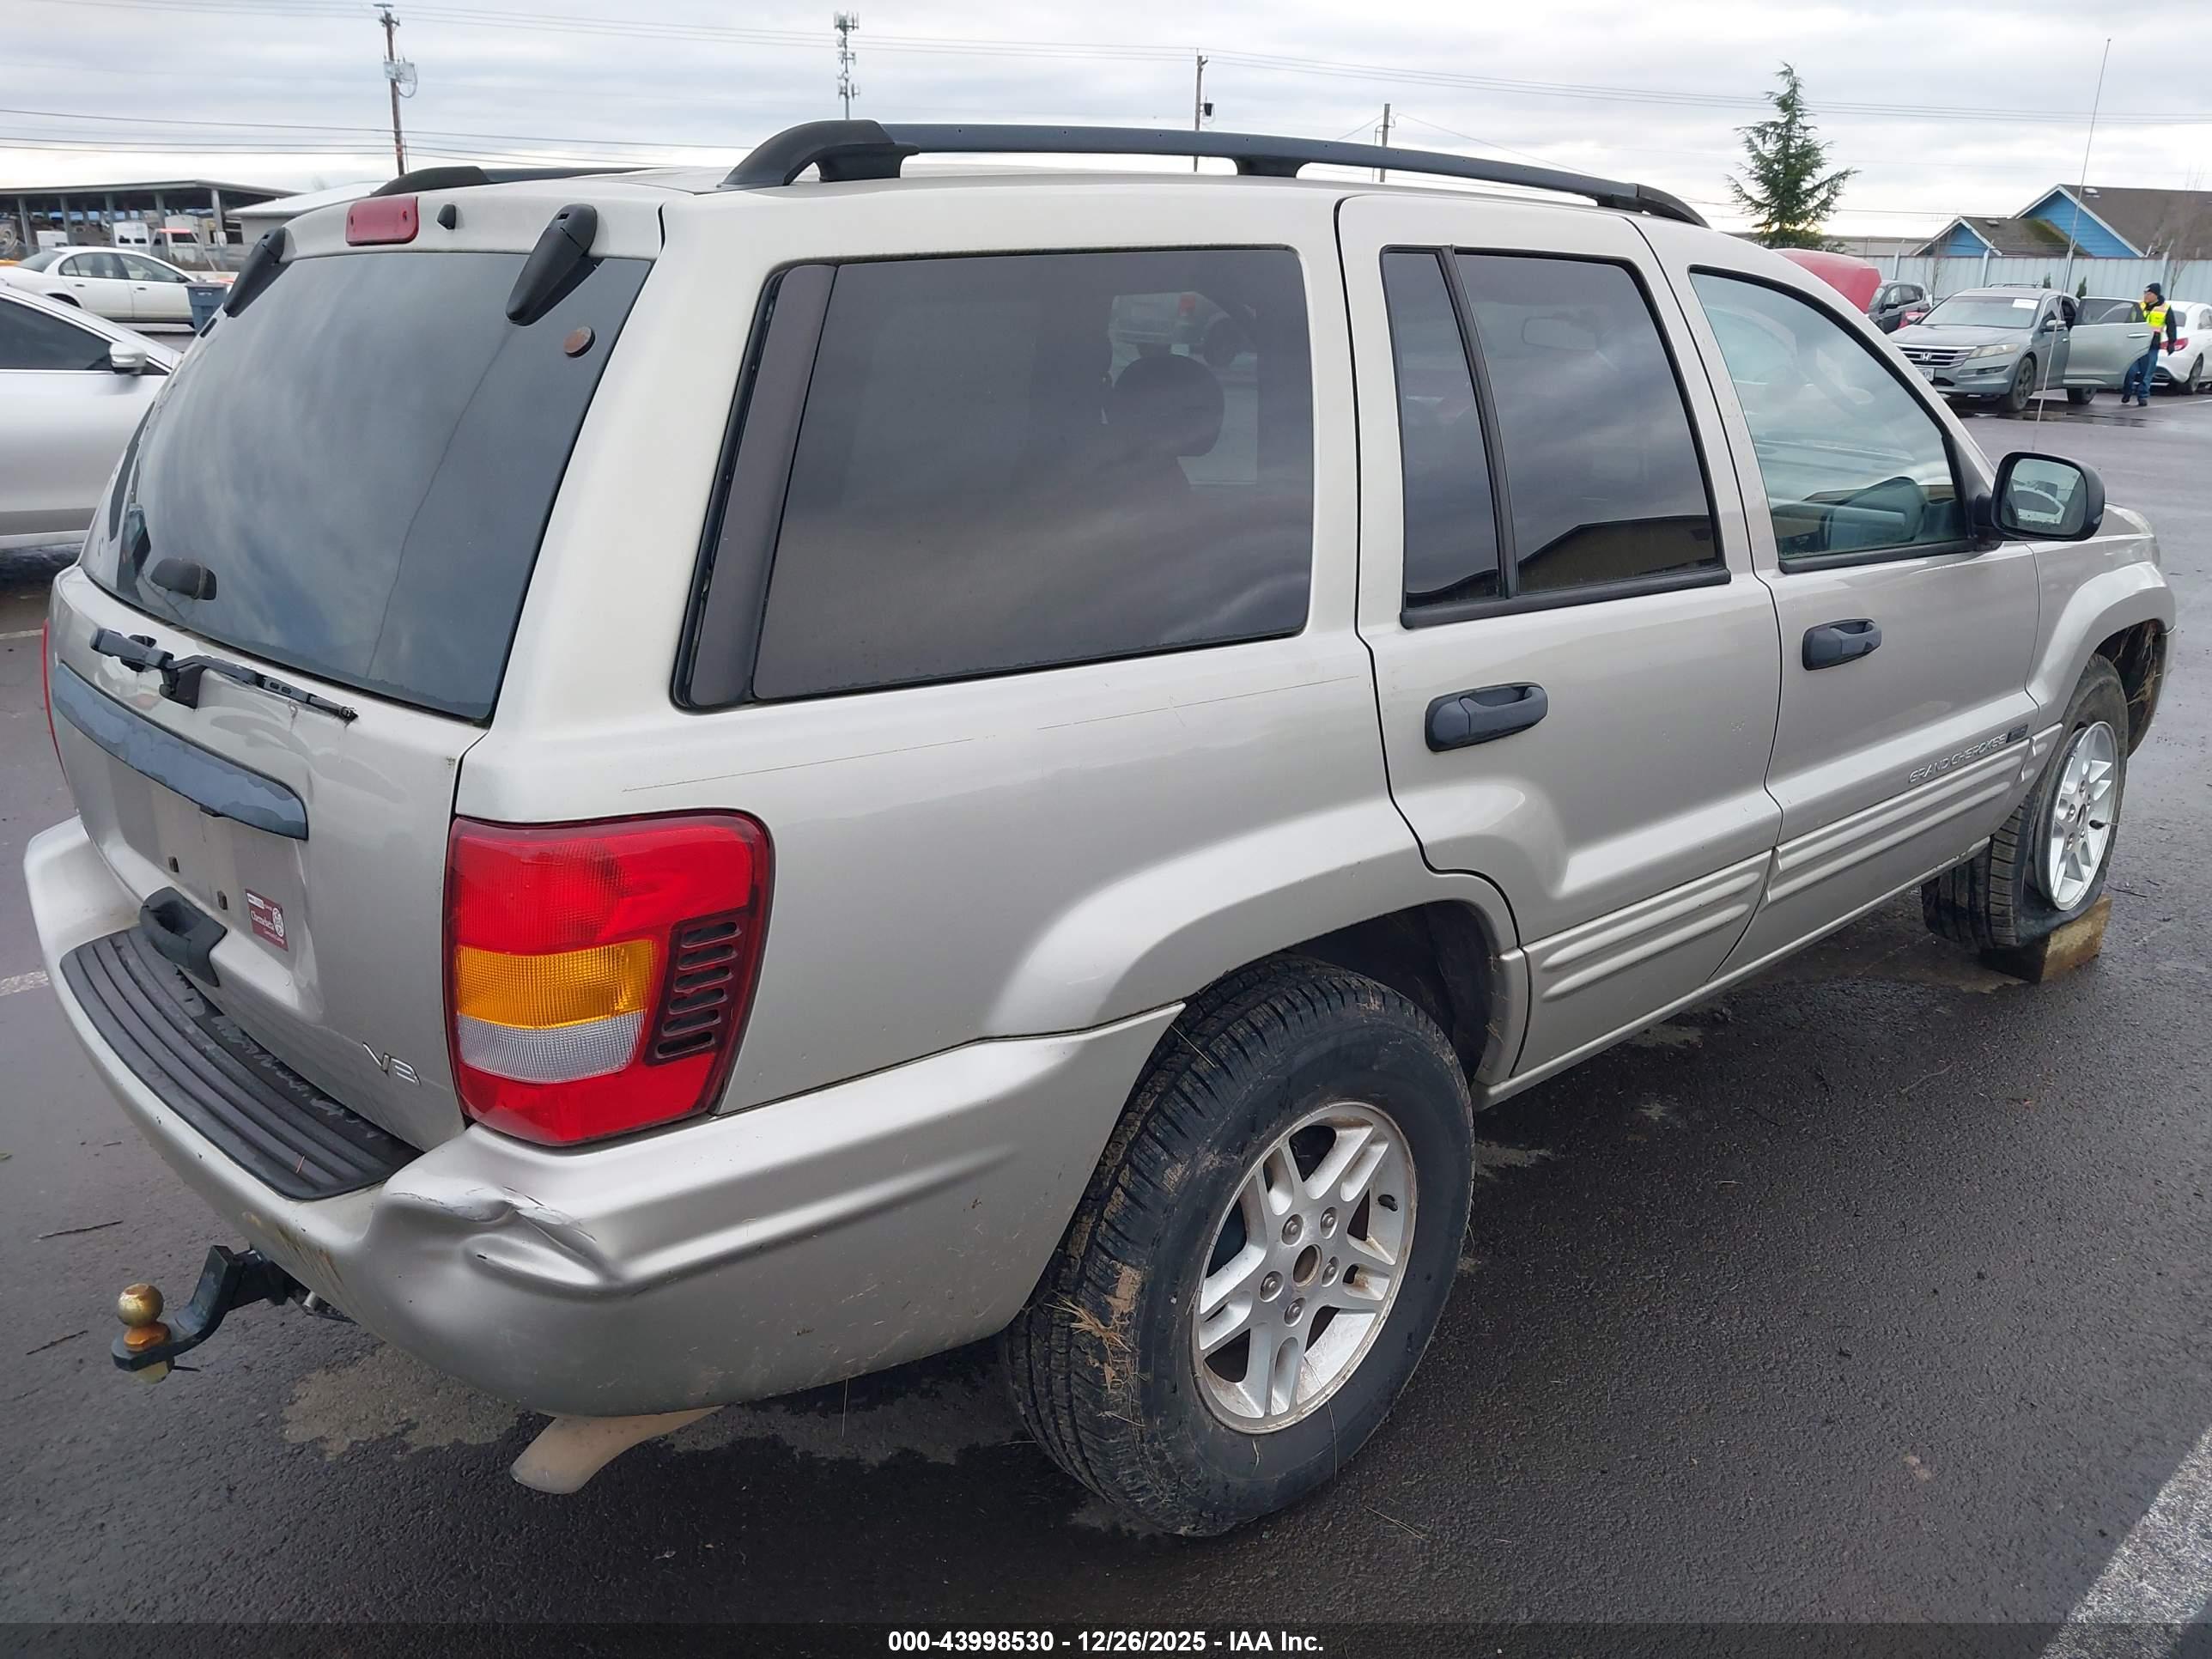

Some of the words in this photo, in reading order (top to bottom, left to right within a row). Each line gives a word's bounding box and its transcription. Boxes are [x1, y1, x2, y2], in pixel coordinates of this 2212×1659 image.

[1908, 757, 1951, 783] GRAND
[1950, 732, 2007, 765] CHEROKEE
[362, 1042, 422, 1086] V8
